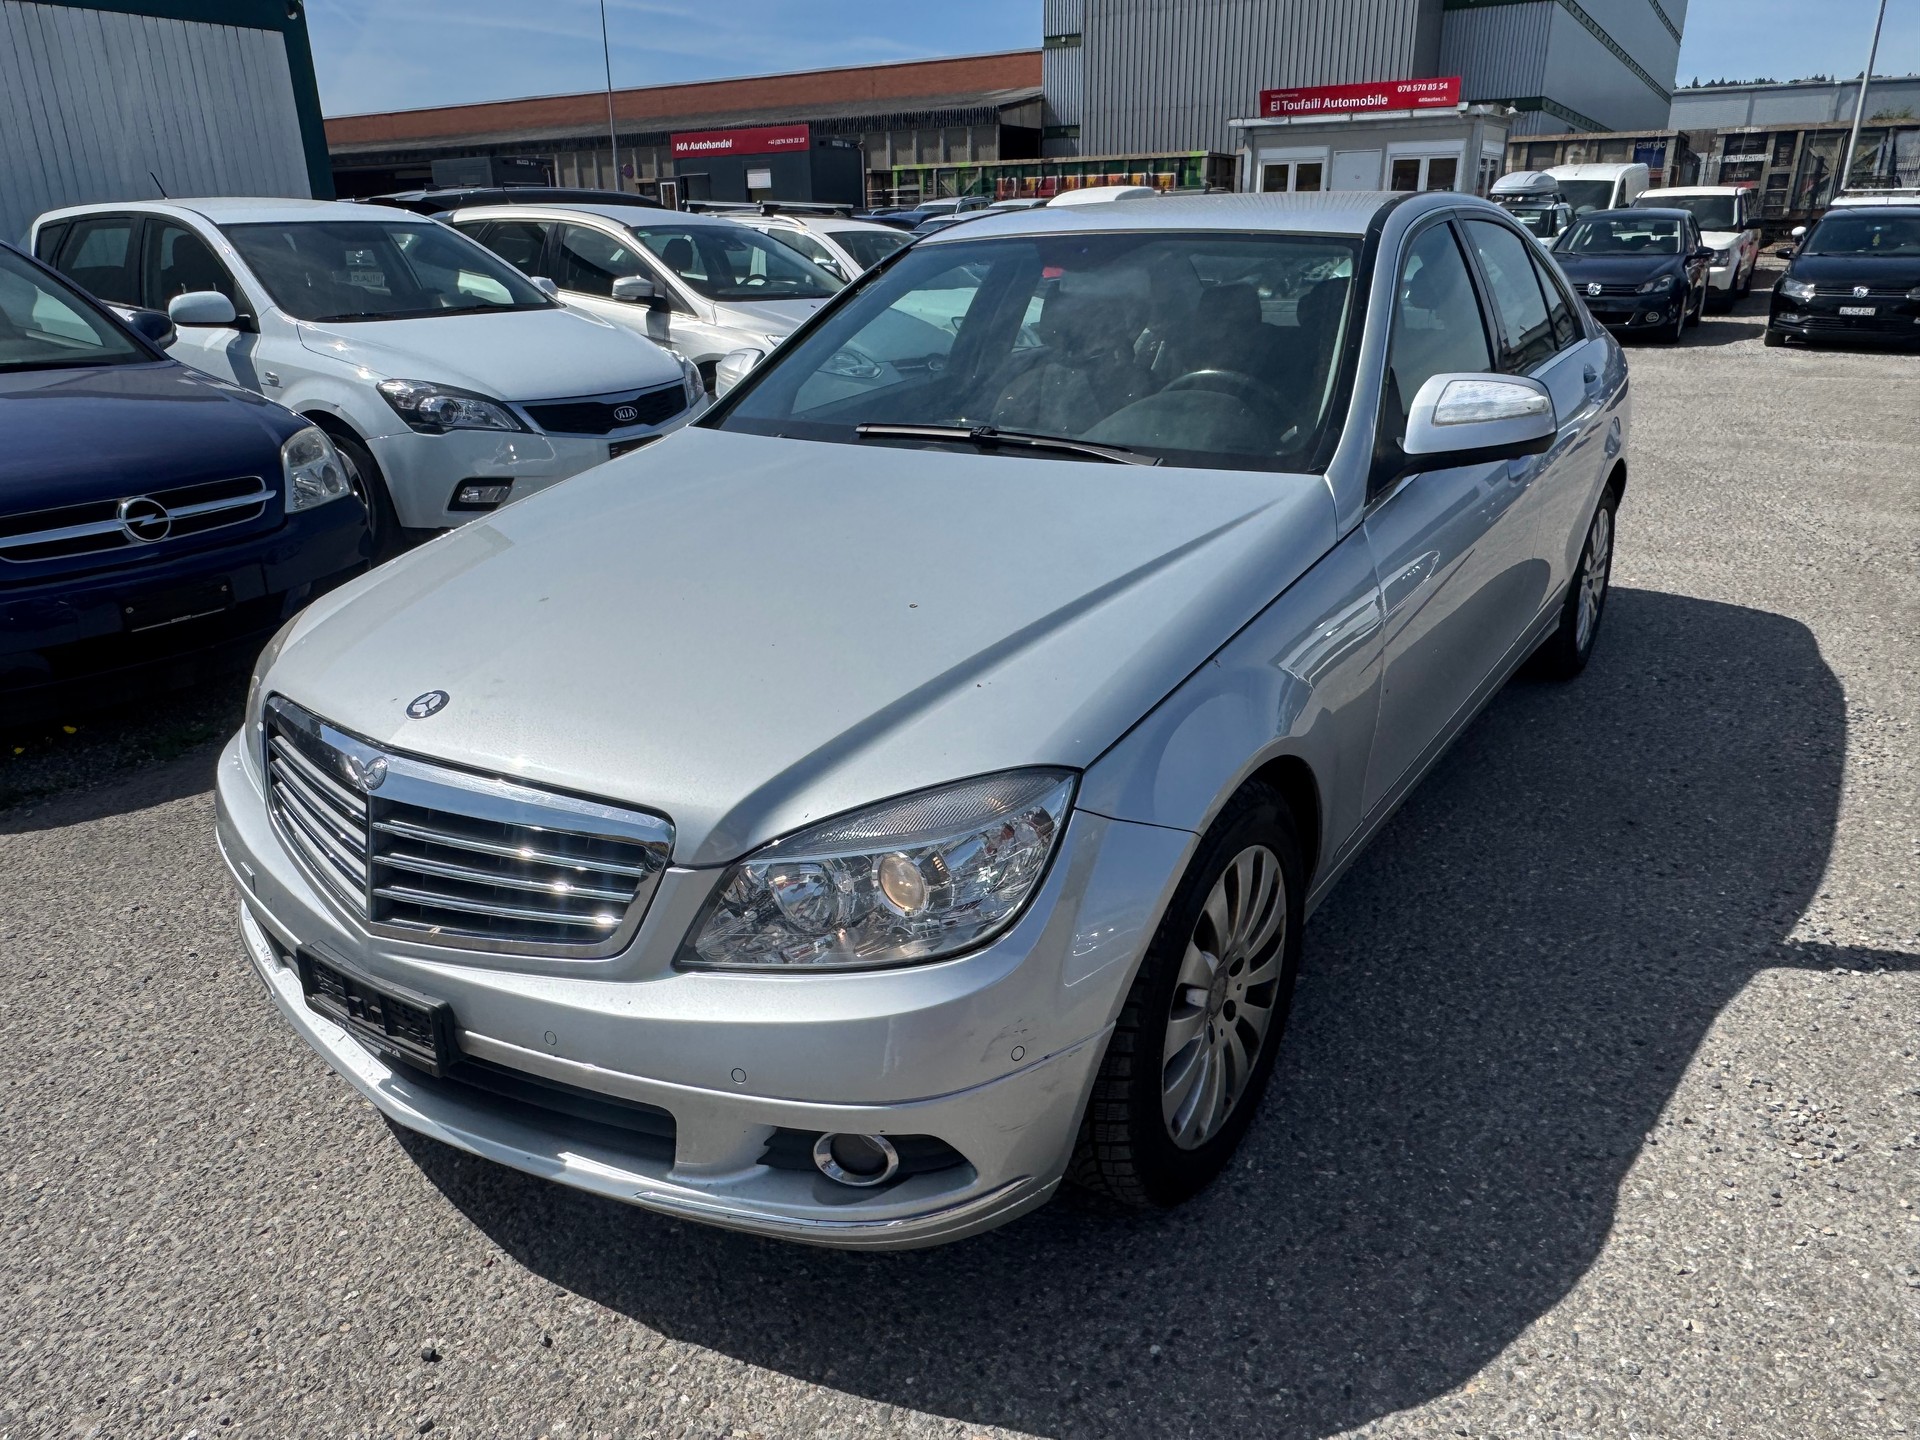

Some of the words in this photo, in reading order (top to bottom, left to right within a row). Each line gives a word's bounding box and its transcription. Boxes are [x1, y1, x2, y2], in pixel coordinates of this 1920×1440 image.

[1270, 101, 1280, 111] El
[1282, 98, 1321, 111] Toufaili
[1322, 94, 1389, 109] Automobile
[676, 142, 688, 151] MA
[689, 139, 733, 151] Autohandel
[1636, 141, 1667, 150] cargo
[617, 408, 635, 419] KIA
